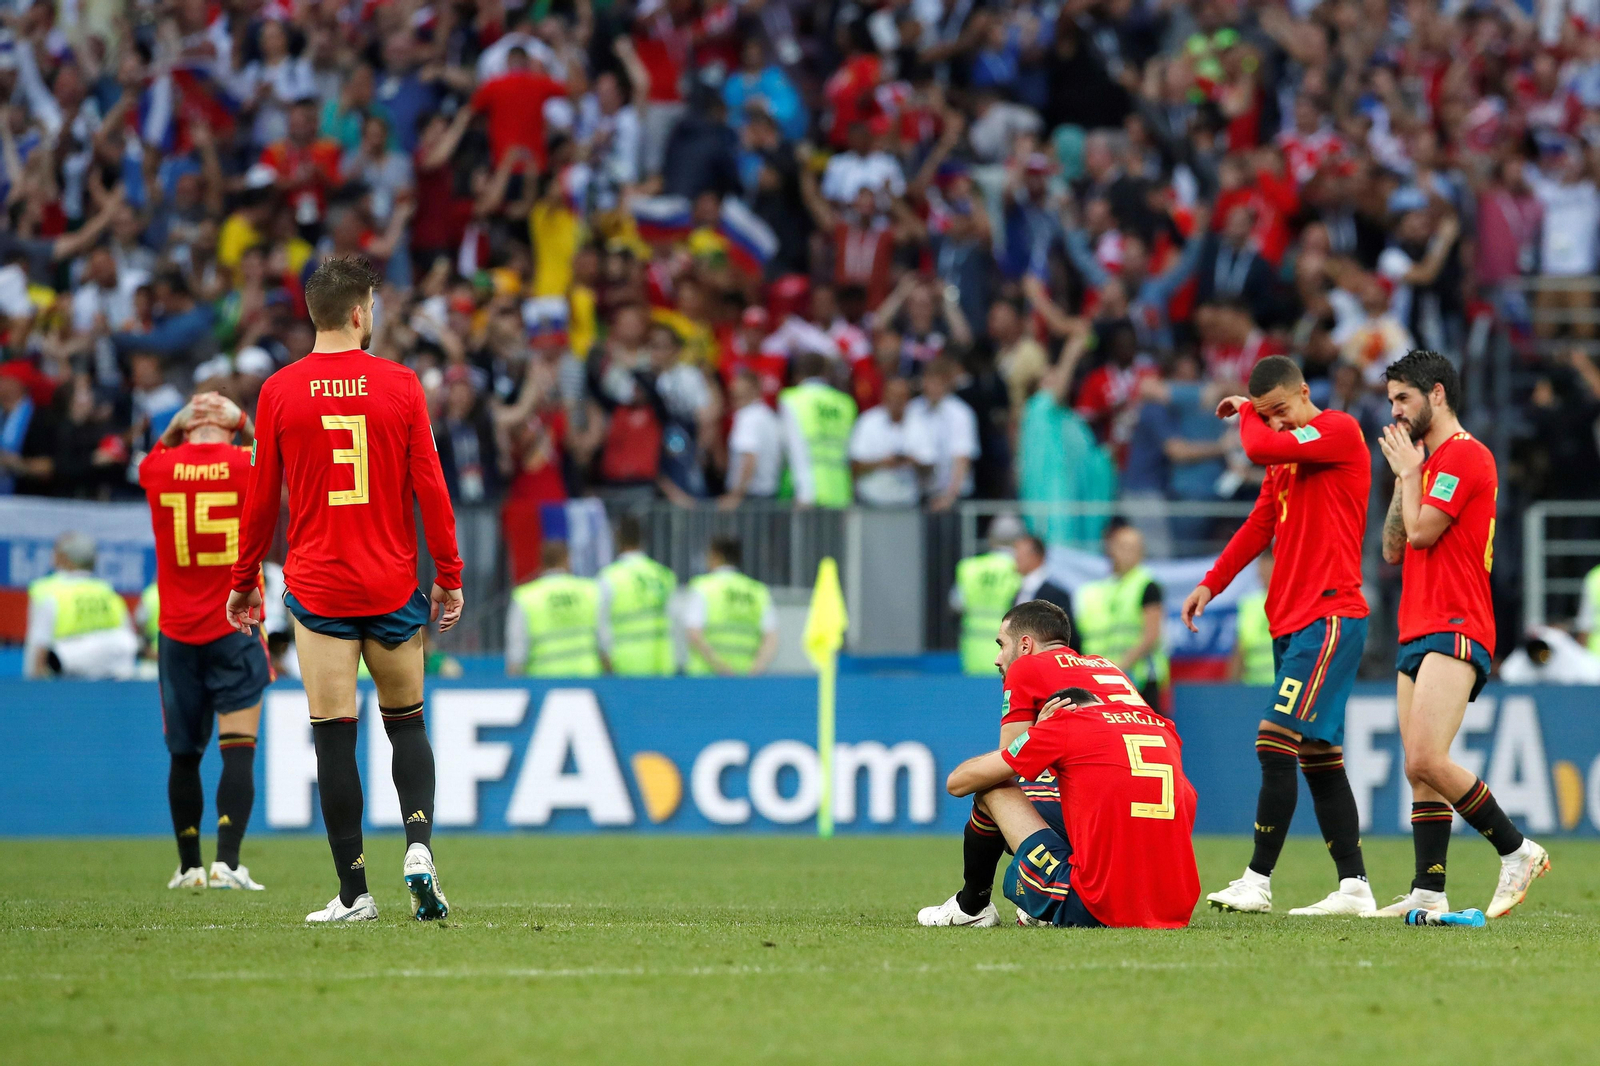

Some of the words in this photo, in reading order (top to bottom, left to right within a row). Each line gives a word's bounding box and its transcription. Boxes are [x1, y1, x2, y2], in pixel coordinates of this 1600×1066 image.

[309, 375, 369, 397] PIQUÉ
[173, 461, 230, 481] RAMOS
[320, 414, 370, 506] 3
[159, 491, 240, 567] 15
[1273, 676, 1303, 715] 9
[1121, 733, 1176, 821] 5
[1026, 843, 1061, 876] 5
